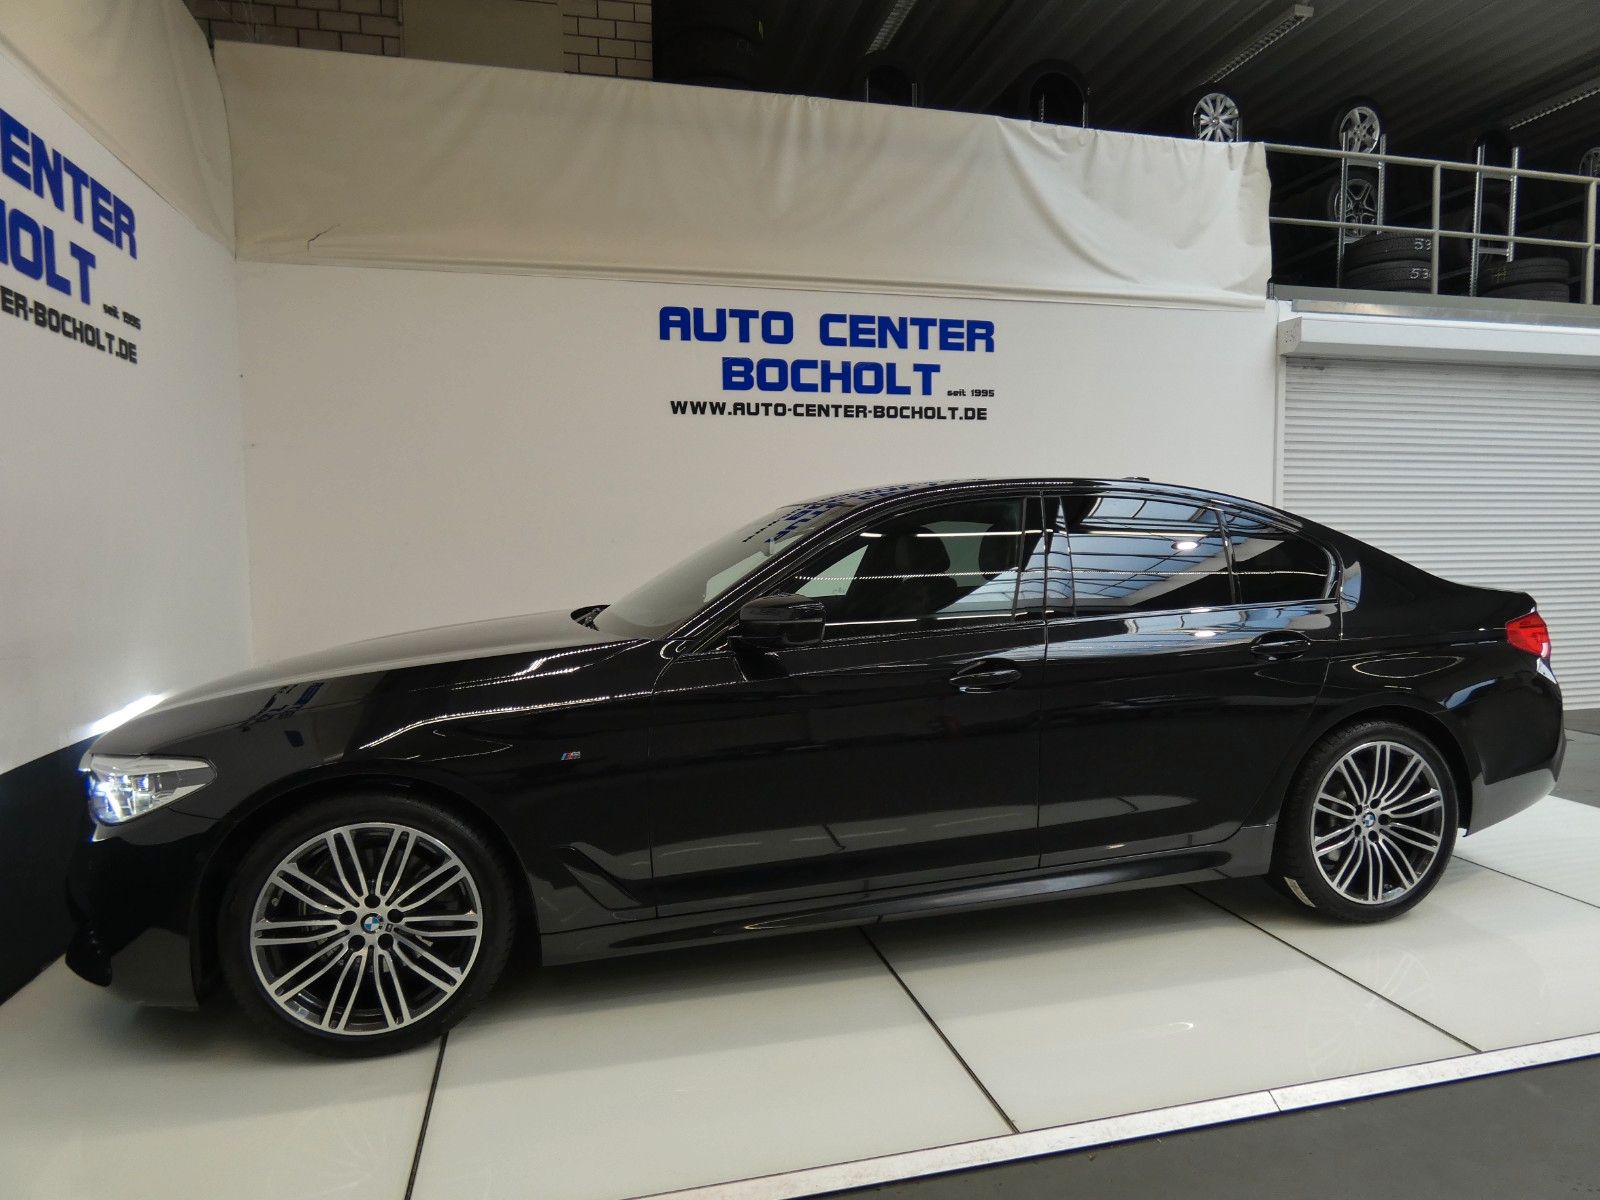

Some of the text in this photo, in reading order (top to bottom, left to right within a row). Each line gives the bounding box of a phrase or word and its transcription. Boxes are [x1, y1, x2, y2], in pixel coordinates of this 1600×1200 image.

[0, 199, 96, 306] OLT
[659, 306, 995, 353] AUTO CENTER
[722, 356, 995, 398] BOCHOLT seit 1995
[670, 400, 988, 421] WWW.AUTO-CENTER-BOCHOLT.DE
